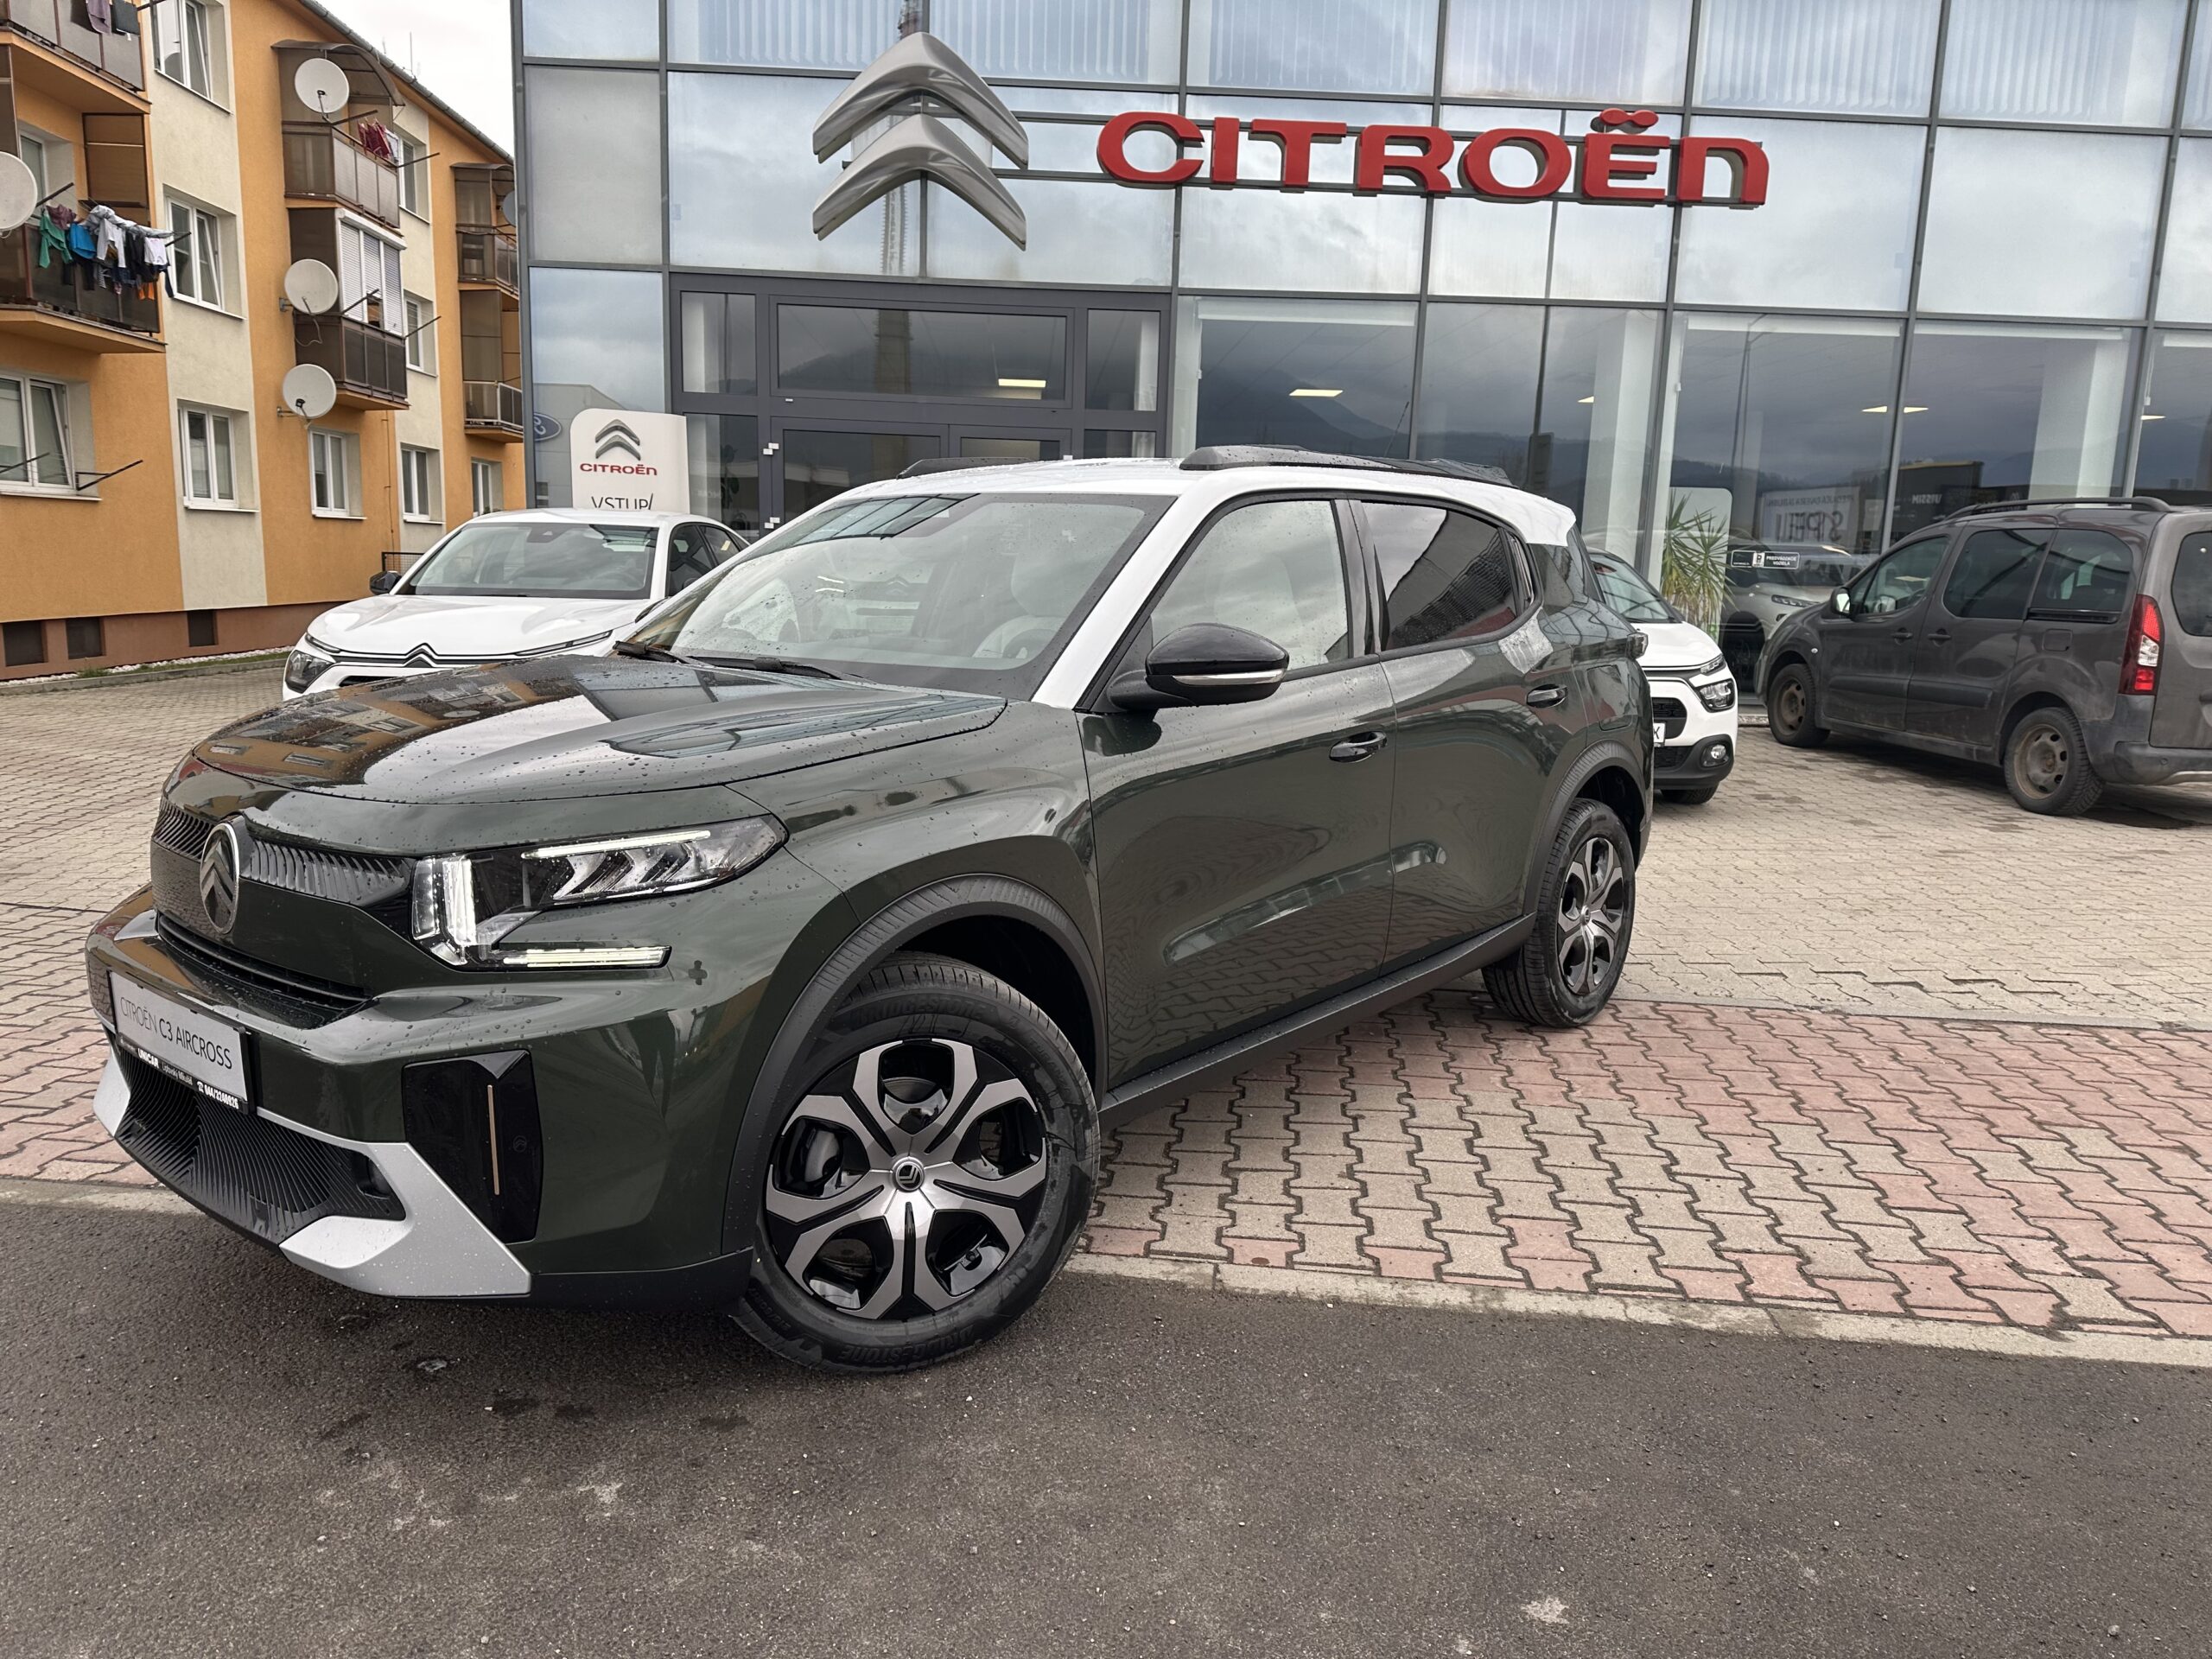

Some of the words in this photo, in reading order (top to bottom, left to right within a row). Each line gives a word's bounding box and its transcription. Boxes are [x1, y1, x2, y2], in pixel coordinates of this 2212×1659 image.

[853, 997, 988, 1026] BRIDGESTONE
[120, 996, 157, 1033] CITROËN
[159, 1018, 173, 1041] C3
[175, 1026, 232, 1070] AIRCROSS
[137, 1047, 159, 1069] UNICAR
